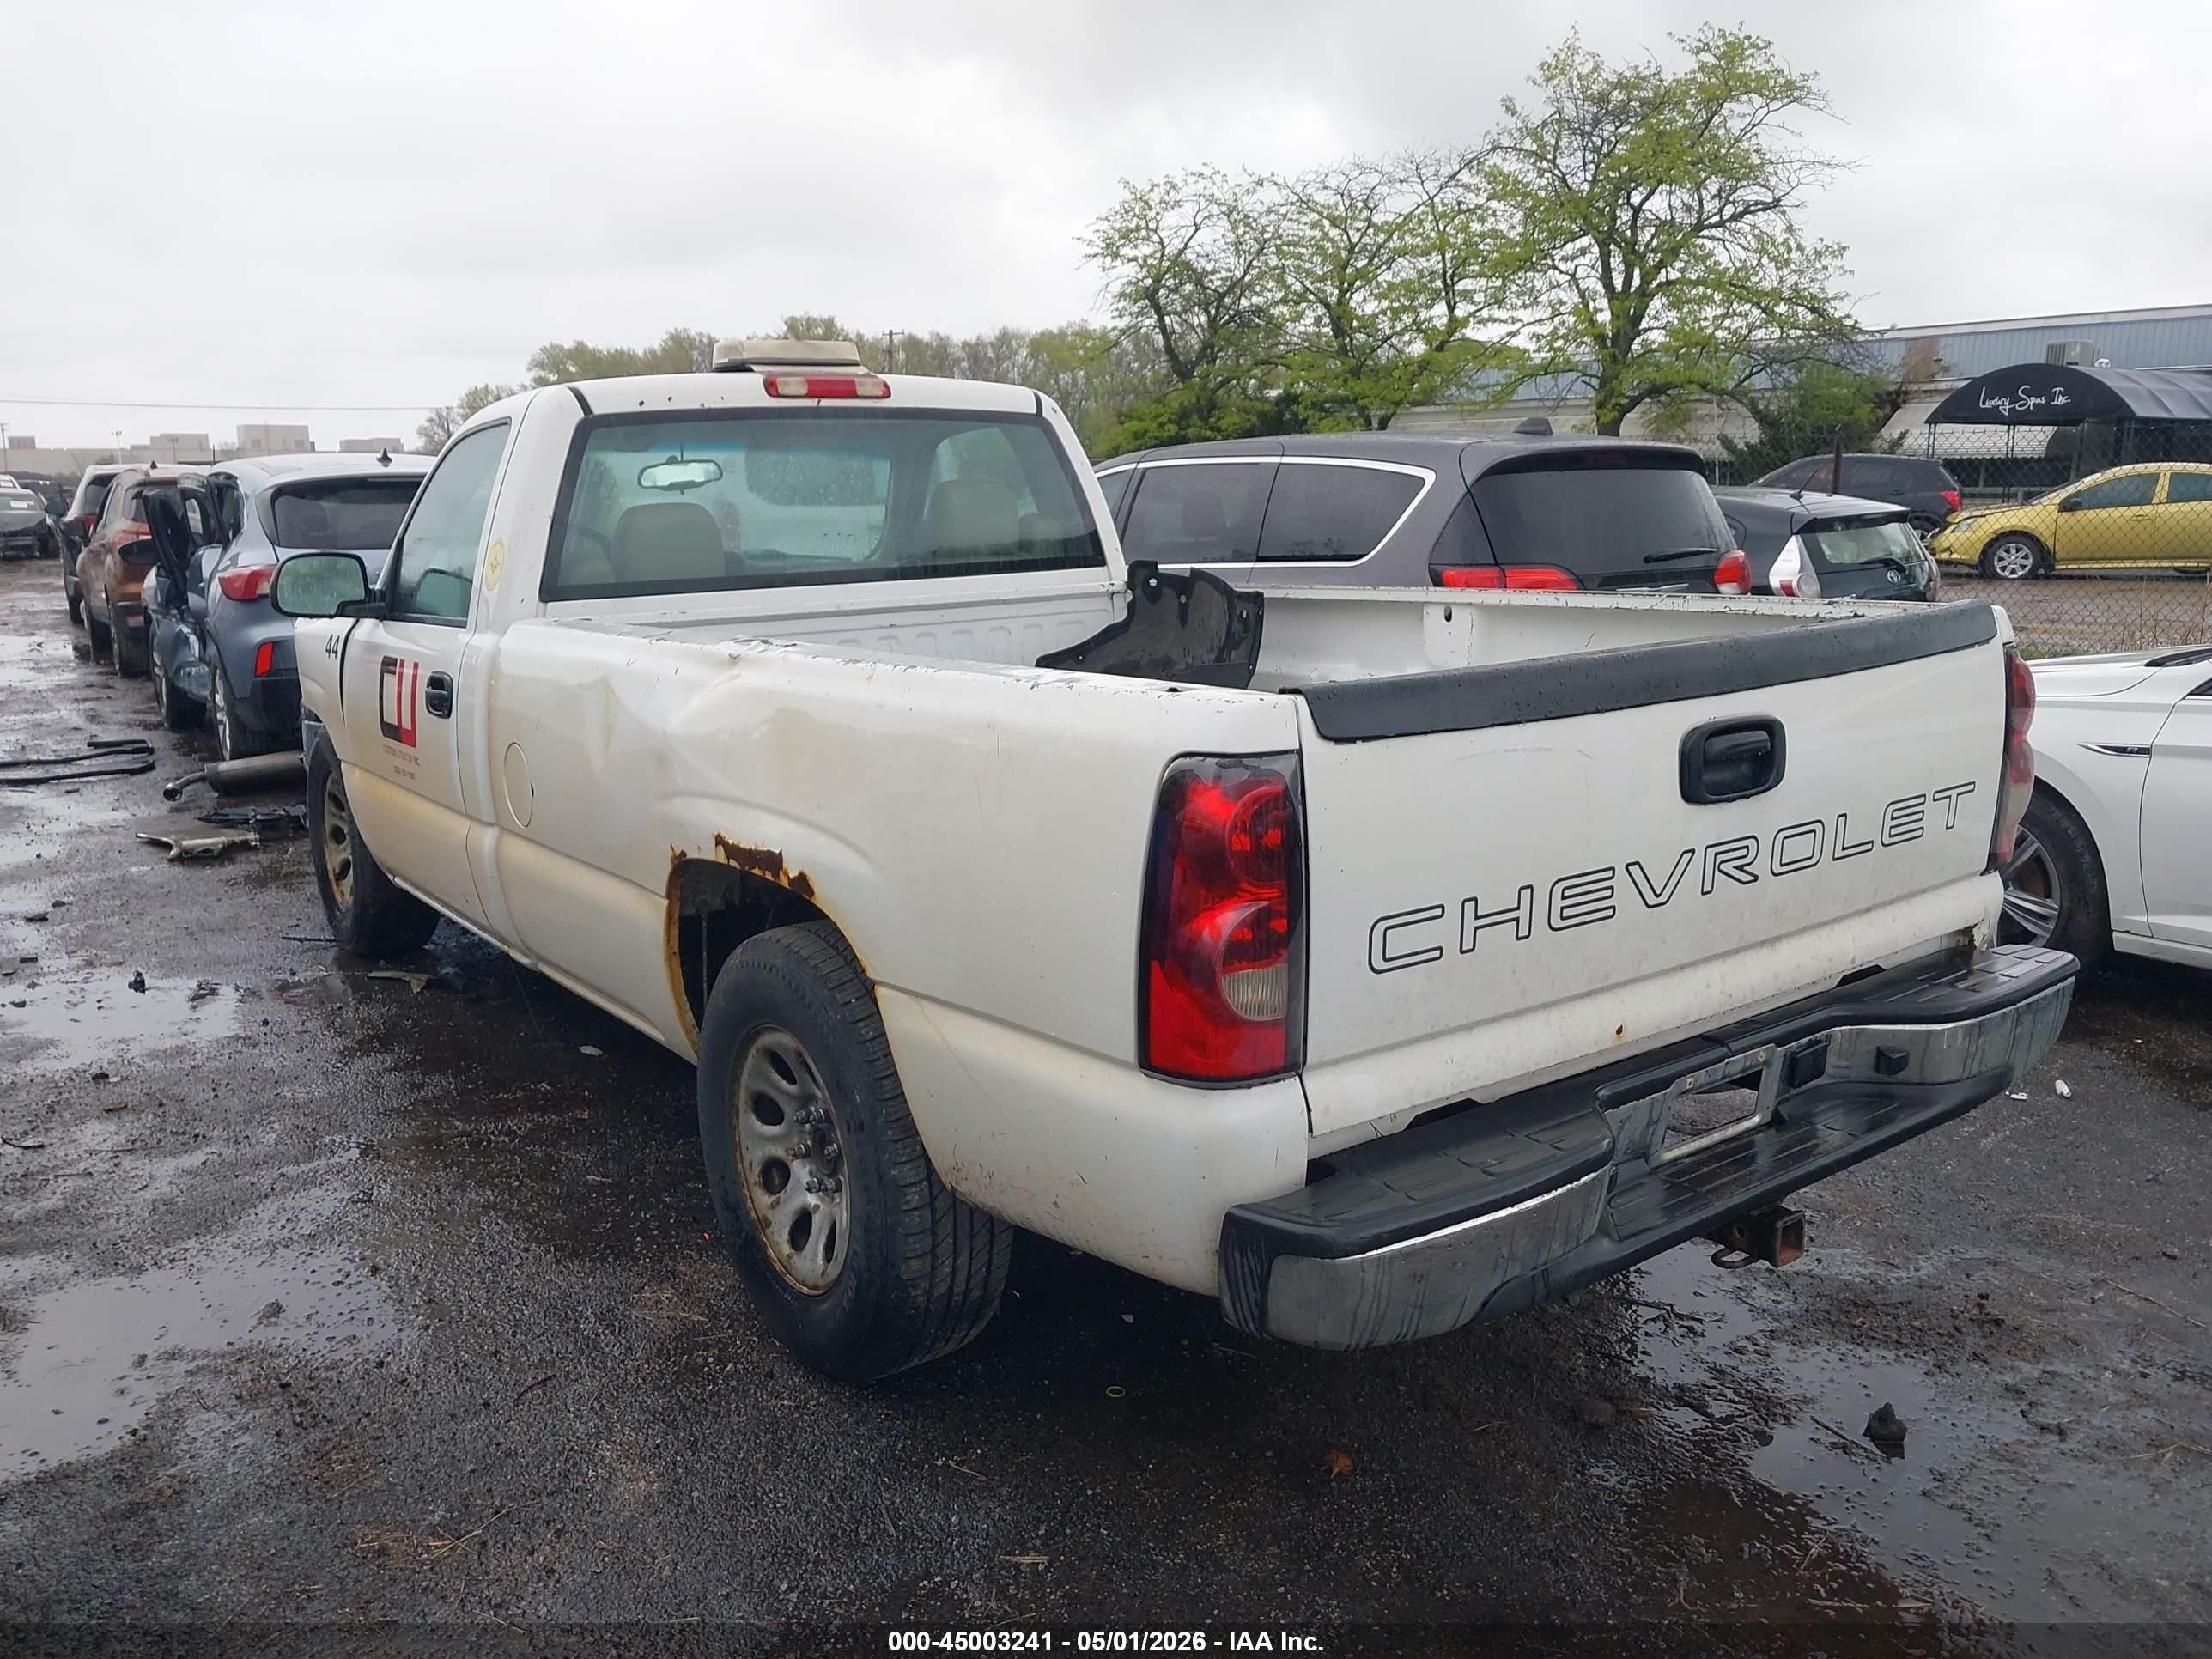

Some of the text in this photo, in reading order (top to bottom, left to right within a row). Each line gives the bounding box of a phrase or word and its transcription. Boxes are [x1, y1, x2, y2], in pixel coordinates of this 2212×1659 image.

[1978, 385, 2072, 416] Luxury Spas Inc.
[325, 634, 340, 659] 44
[1367, 781, 1976, 975] CHEVROLET
